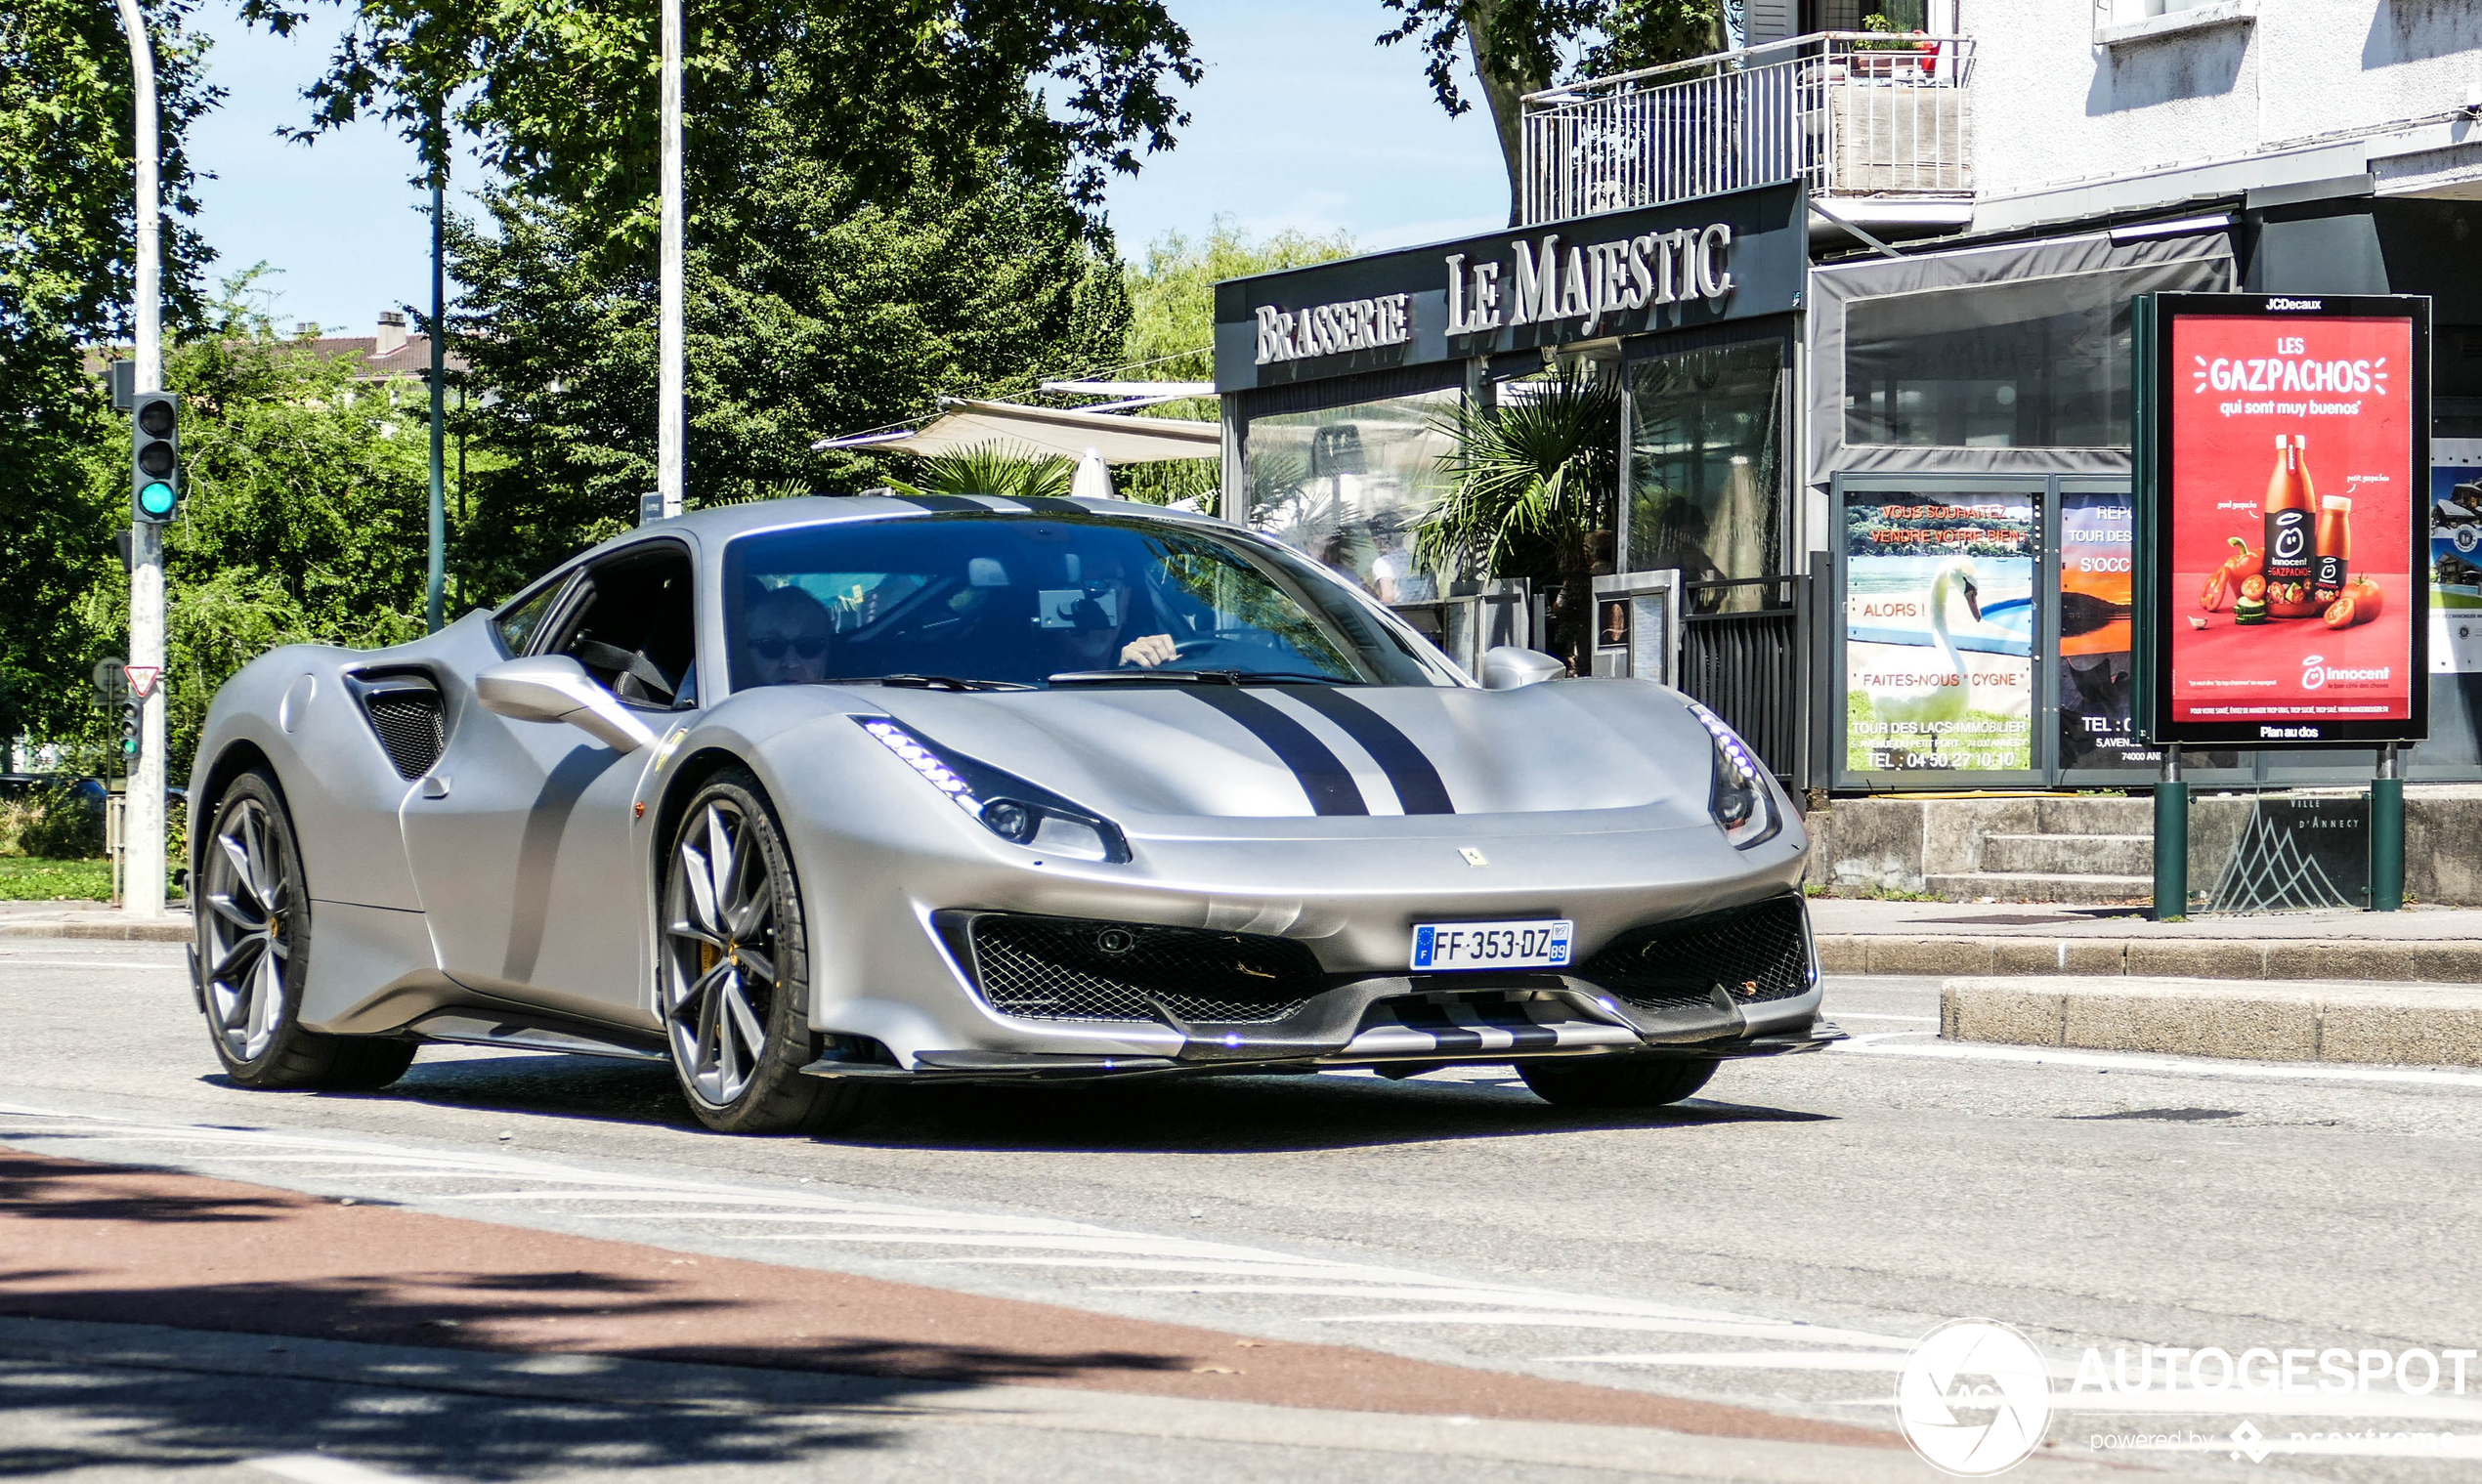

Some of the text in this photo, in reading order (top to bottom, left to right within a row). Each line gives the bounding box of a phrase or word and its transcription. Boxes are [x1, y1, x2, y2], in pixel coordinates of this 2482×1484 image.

[1255, 223, 1731, 364] BRASSERIE LE MAJESTIC
[2265, 298, 2322, 311] JCDecaux
[2277, 337, 2305, 355] LES
[2209, 358, 2371, 392] GAZPACHOS
[2219, 400, 2243, 417] qui
[2245, 400, 2275, 414] sont
[2277, 403, 2307, 417] muy
[1882, 505, 2007, 519] VOUS SOUHAITEZ
[1870, 530, 1931, 543] VENDRE
[1935, 530, 1984, 543] VOTRE
[1987, 530, 2020, 543] BIEN
[2068, 530, 2132, 542] TOUR DES
[2272, 557, 2308, 567] innocent
[2271, 568, 2308, 576] GAZPACHO
[1863, 604, 1917, 617] ALORS
[2327, 666, 2390, 680] innocent
[1863, 674, 1960, 686] FAITES-NOUS
[1853, 721, 2027, 734] TOUR DES LACS IMMOBILIER
[2081, 717, 2113, 732] TEL
[2260, 726, 2319, 738] Plan au dos
[1861, 740, 1895, 748] AVENUE
[1895, 740, 1908, 748] DU
[1910, 740, 1934, 748] PETIT
[1935, 740, 1958, 748] PORT
[1990, 739, 2027, 747] ANNECY
[1865, 753, 1896, 768] TEL
[1907, 753, 1926, 768] 04
[1930, 753, 1947, 768] 50
[1951, 753, 1973, 767] 27
[1976, 753, 1991, 767] 10
[1998, 753, 2015, 767] 10
[2121, 752, 2146, 761] 74000
[1434, 929, 1551, 960] FF-353-DZ
[1421, 951, 1428, 959] F
[1551, 945, 1566, 959] 89
